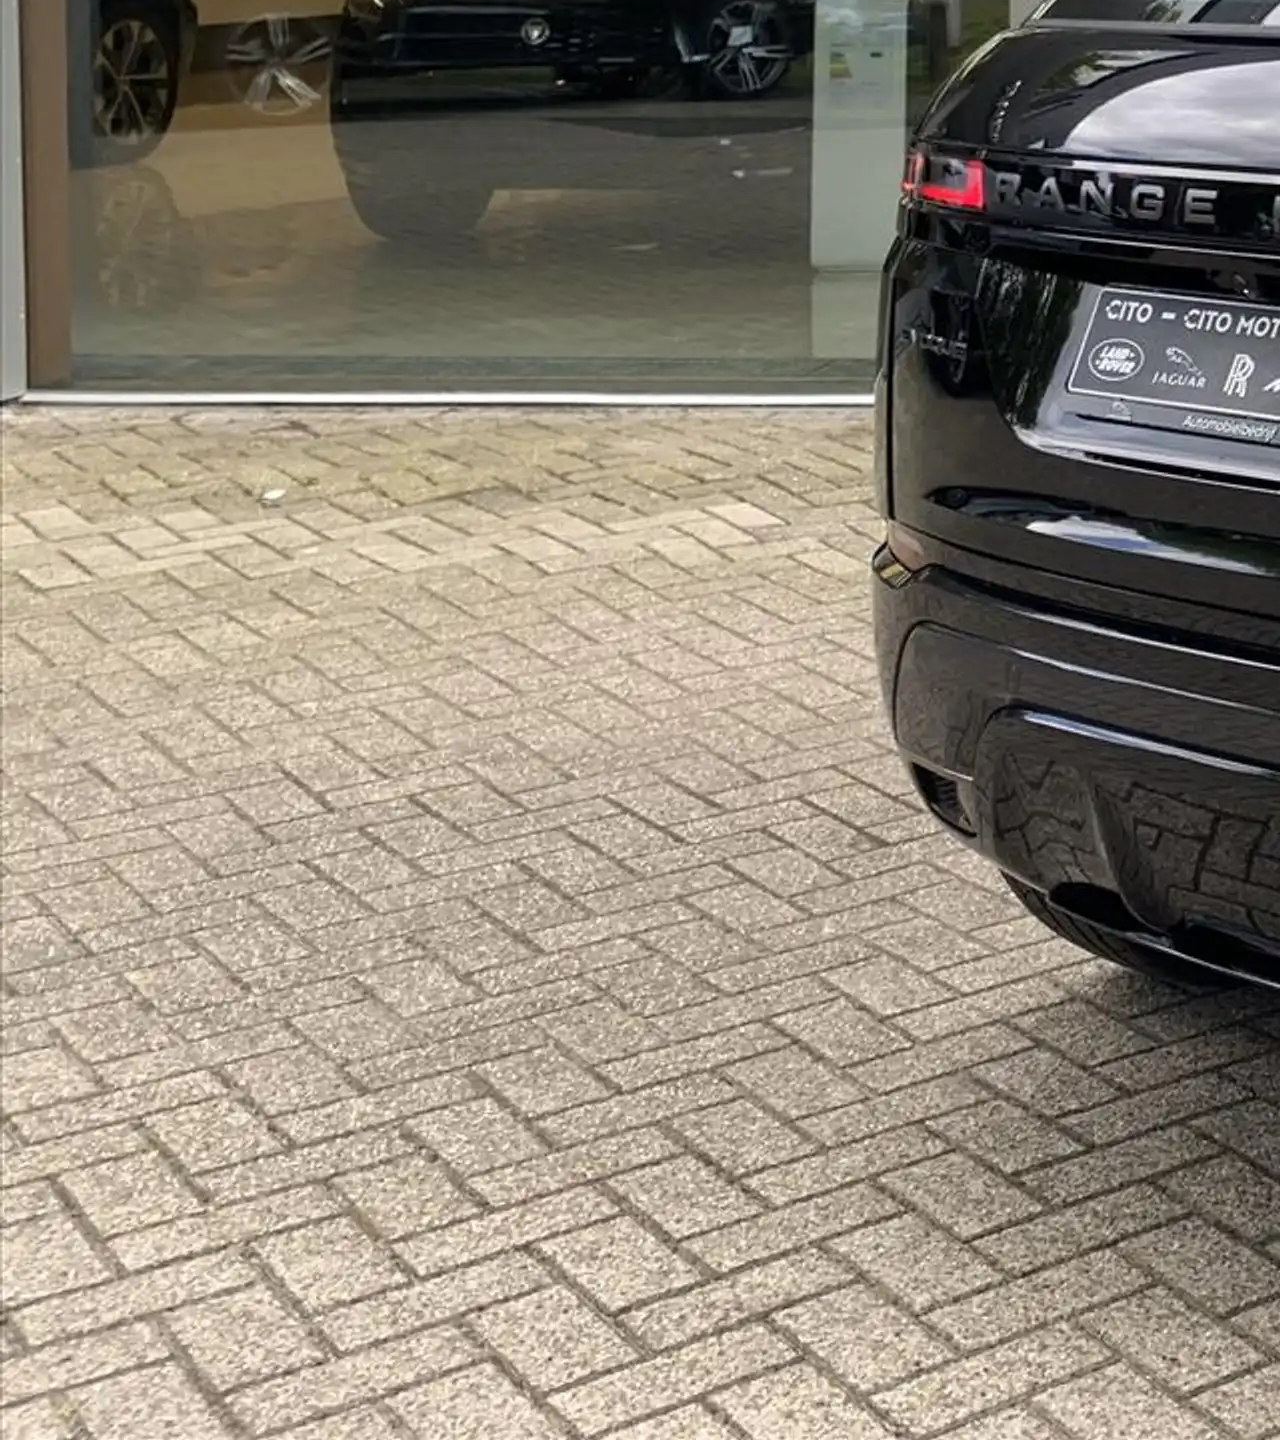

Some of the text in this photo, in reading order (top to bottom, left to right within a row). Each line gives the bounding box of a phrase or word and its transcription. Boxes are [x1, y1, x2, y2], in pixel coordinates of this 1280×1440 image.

[994, 171, 1220, 226] RANGE
[1105, 299, 1153, 323] CITO
[1183, 308, 1233, 333] CITO
[1151, 371, 1207, 389] JAGUAR
